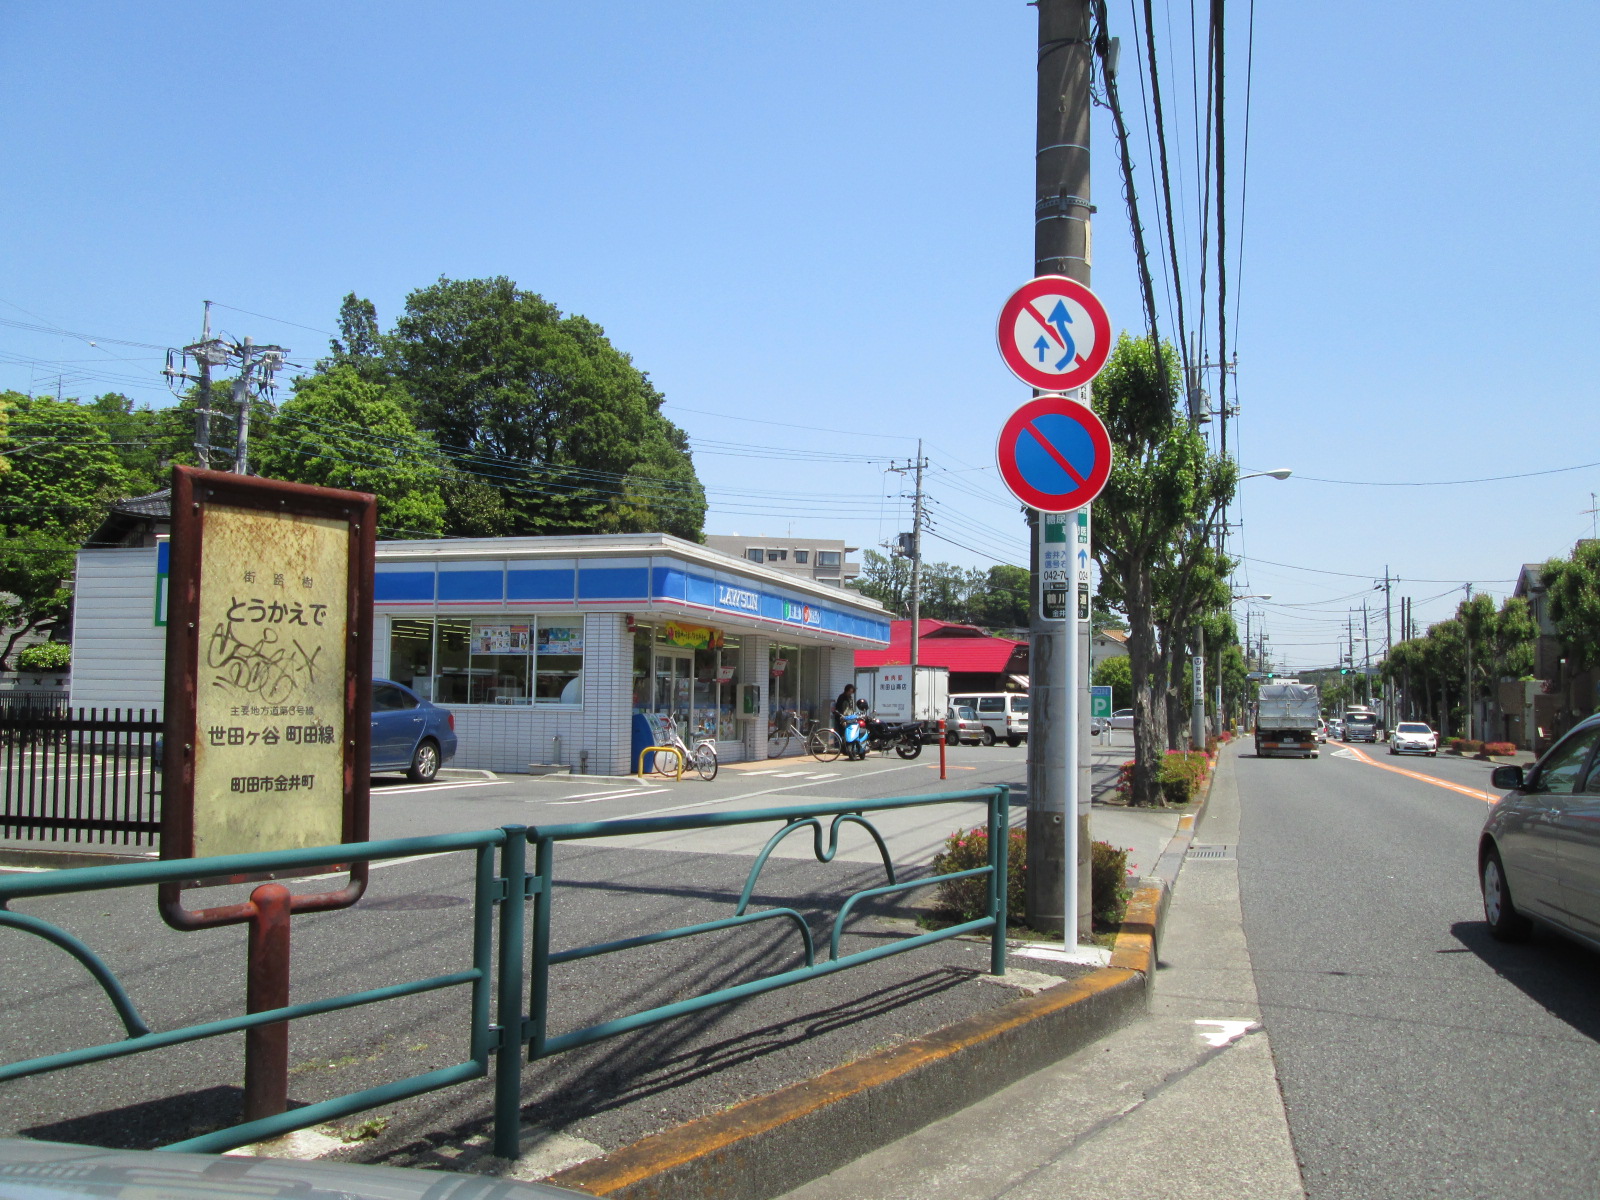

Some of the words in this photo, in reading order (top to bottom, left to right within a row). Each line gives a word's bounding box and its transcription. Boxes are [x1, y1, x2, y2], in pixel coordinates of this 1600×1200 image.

[244, 570, 313, 589] 街路樹
[719, 585, 758, 612] LAWSON
[226, 596, 328, 626] とうかえで
[1093, 698, 1107, 715] P
[230, 774, 316, 794] 町田市金井町
